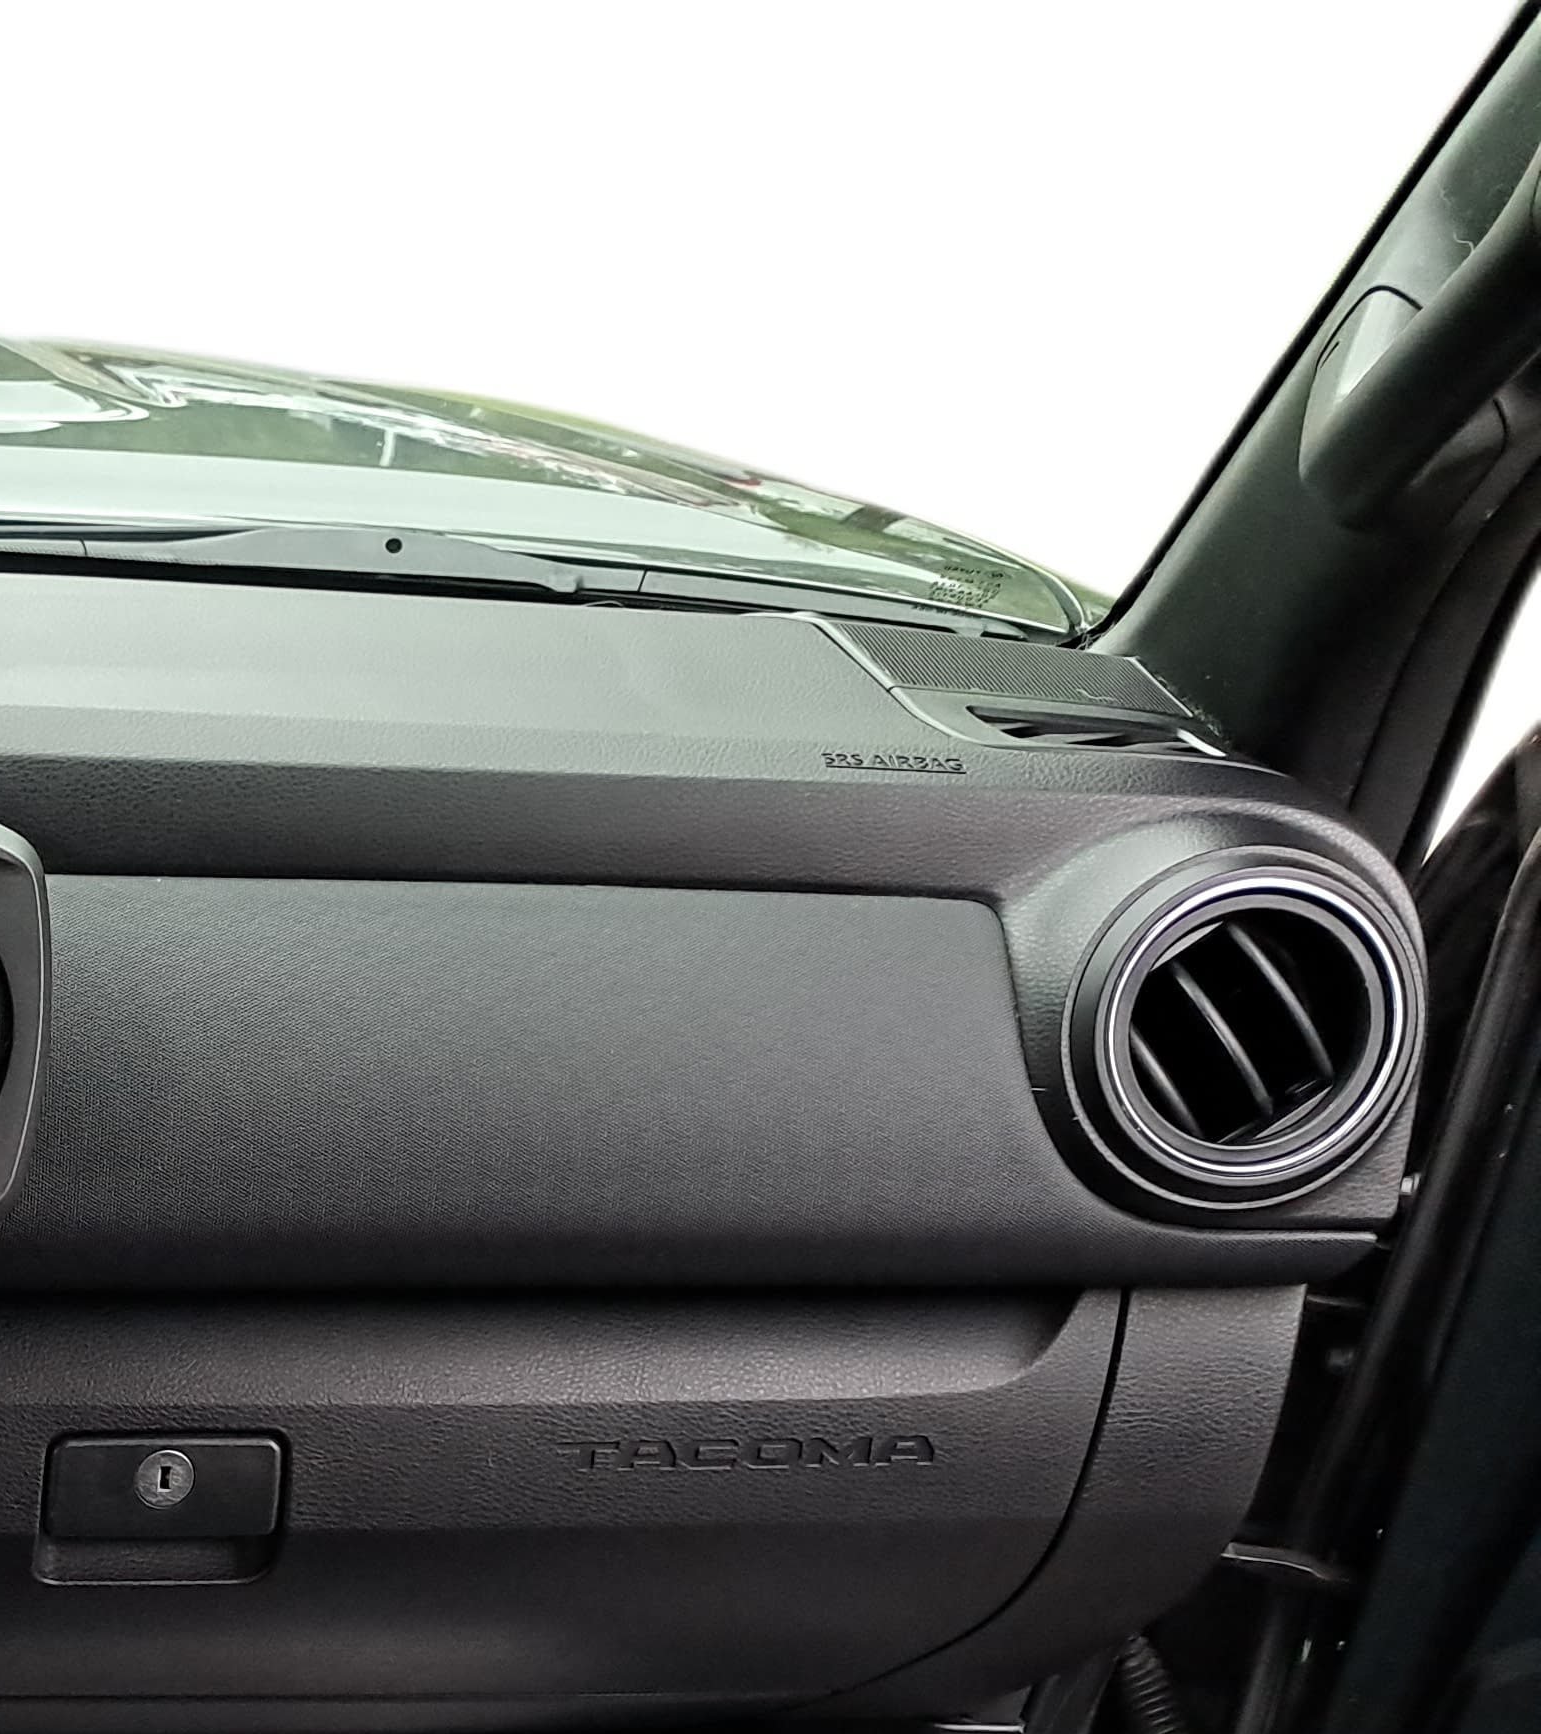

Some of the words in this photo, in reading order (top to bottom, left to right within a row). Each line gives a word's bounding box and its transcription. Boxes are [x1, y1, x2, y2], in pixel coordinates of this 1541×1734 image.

[820, 752, 864, 766] SRS
[873, 754, 964, 771] AIRBAG
[557, 1435, 935, 1471] TACOMA
